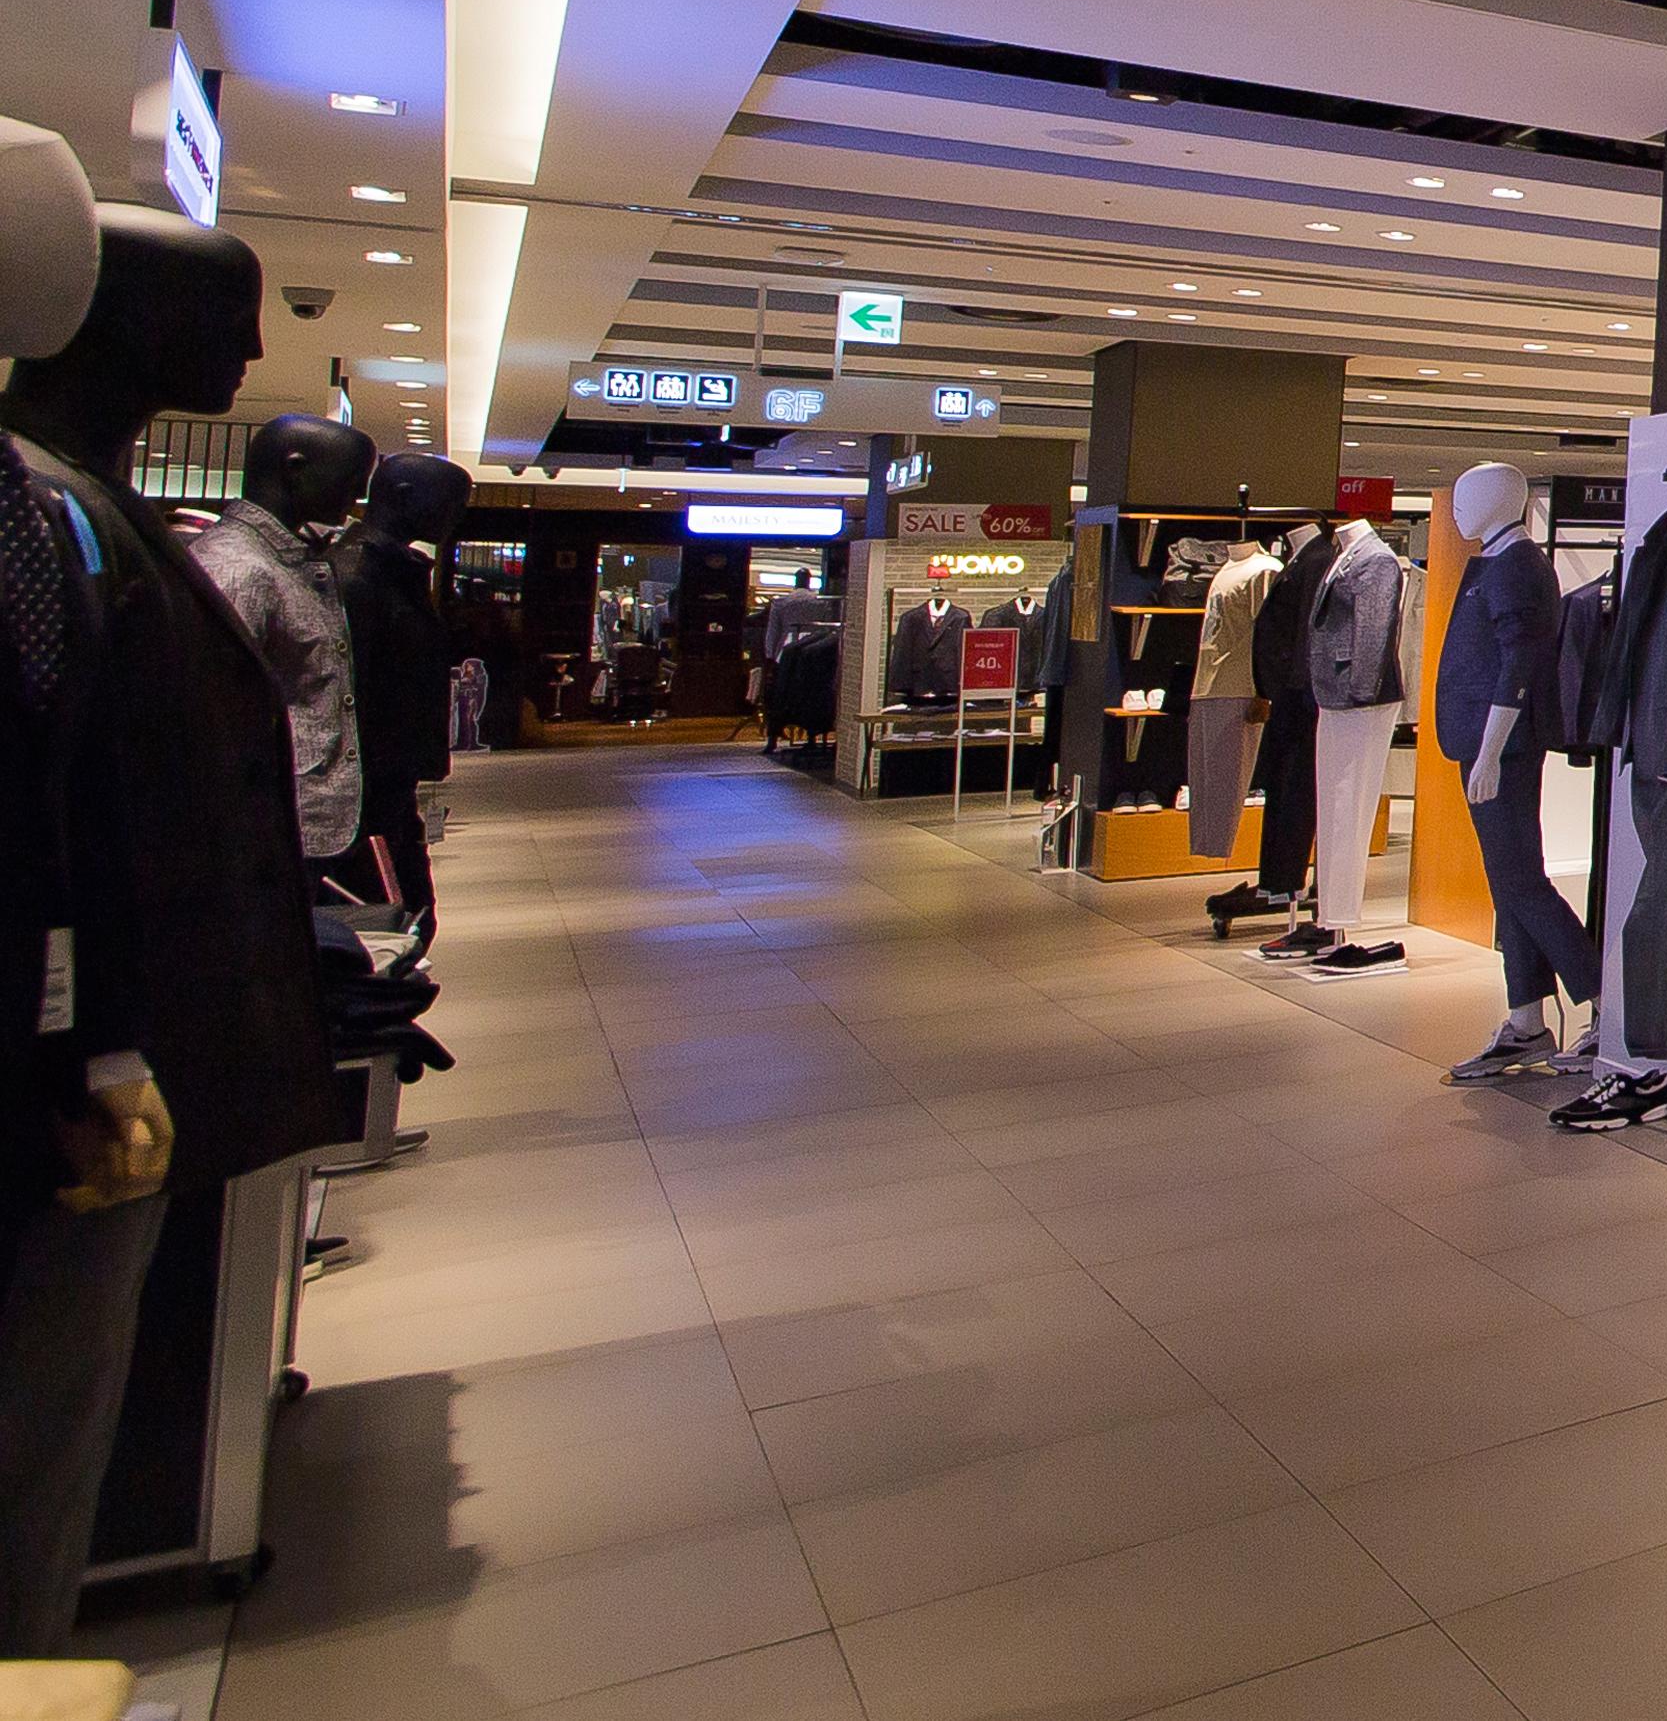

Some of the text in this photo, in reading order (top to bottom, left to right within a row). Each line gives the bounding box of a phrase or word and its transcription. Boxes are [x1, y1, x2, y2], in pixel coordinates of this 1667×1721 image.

[766, 389, 824, 422] 6F
[1341, 480, 1366, 493] off
[905, 513, 966, 533] SALE
[989, 517, 1031, 533] 60%
